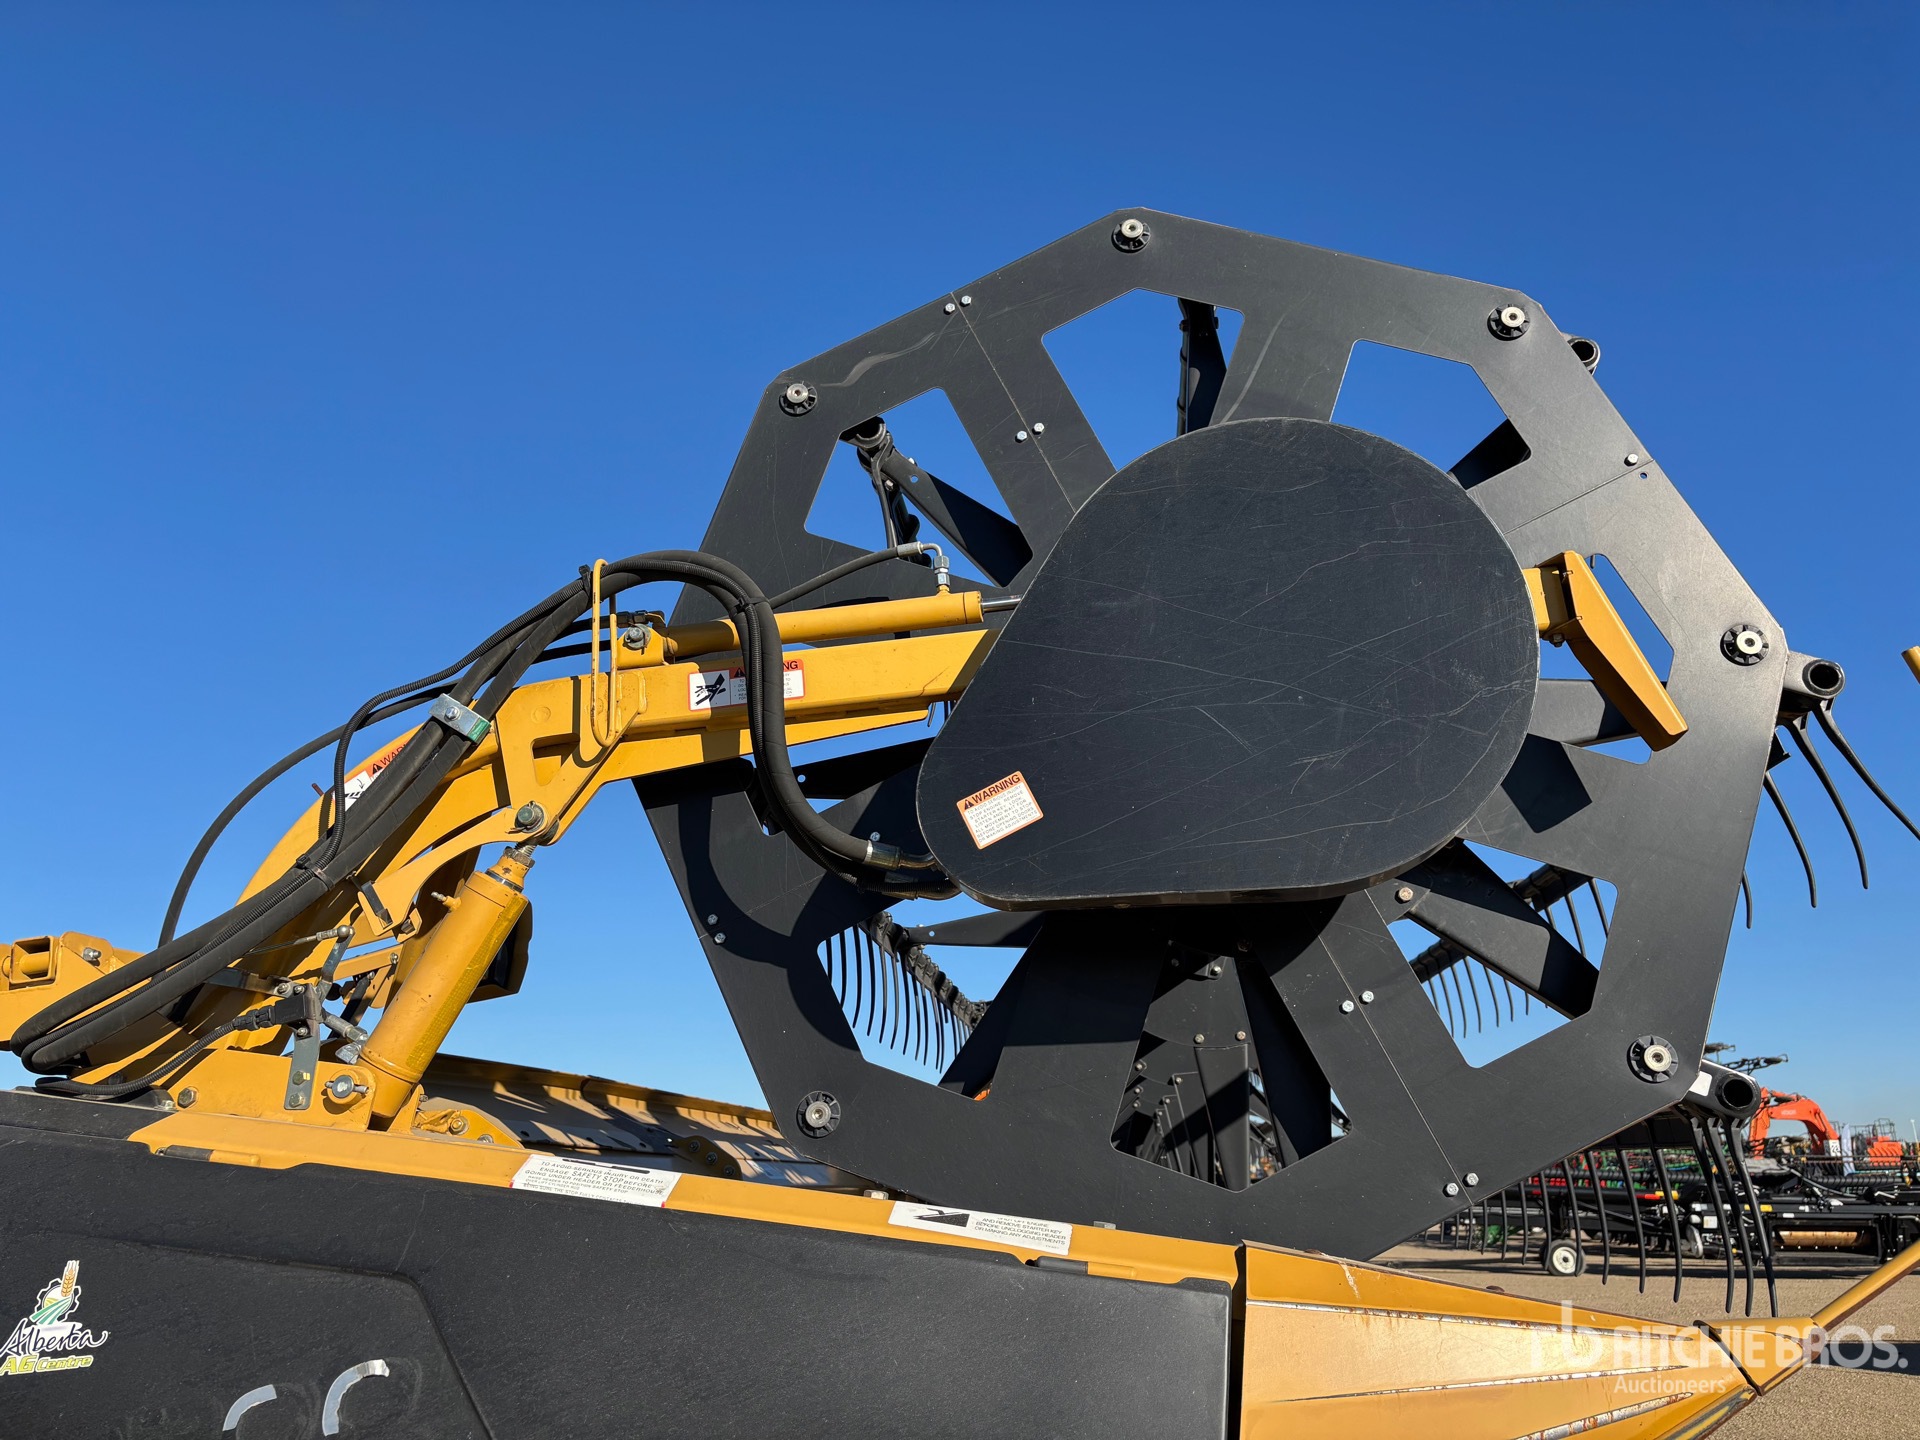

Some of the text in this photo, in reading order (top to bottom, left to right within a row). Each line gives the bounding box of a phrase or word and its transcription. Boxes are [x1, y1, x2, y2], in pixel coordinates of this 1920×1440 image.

[972, 774, 1021, 804] WARNING
[970, 810, 982, 820] STOP
[1004, 790, 1024, 802] REMOVE
[974, 810, 996, 824] STARTER
[975, 817, 992, 828] LISTEN
[984, 812, 1010, 828] MOVEMENT
[540, 1167, 652, 1188] ENGAGE SAFETY STOP BEFORE
[572, 1166, 604, 1175] SERIOUS
[573, 1176, 603, 1185] HEADER
[976, 1221, 1000, 1230] BEFORE
[1000, 1226, 1041, 1236] UNCLOGGING
[996, 1220, 1021, 1228] REMOVE
[1022, 1224, 1050, 1232] STARTER
[984, 1227, 1008, 1236] MAKING
[1022, 1234, 1066, 1245] ADJUSTMENTS
[0, 1318, 108, 1356] Alberta
[0, 1356, 93, 1374] AG Centre
